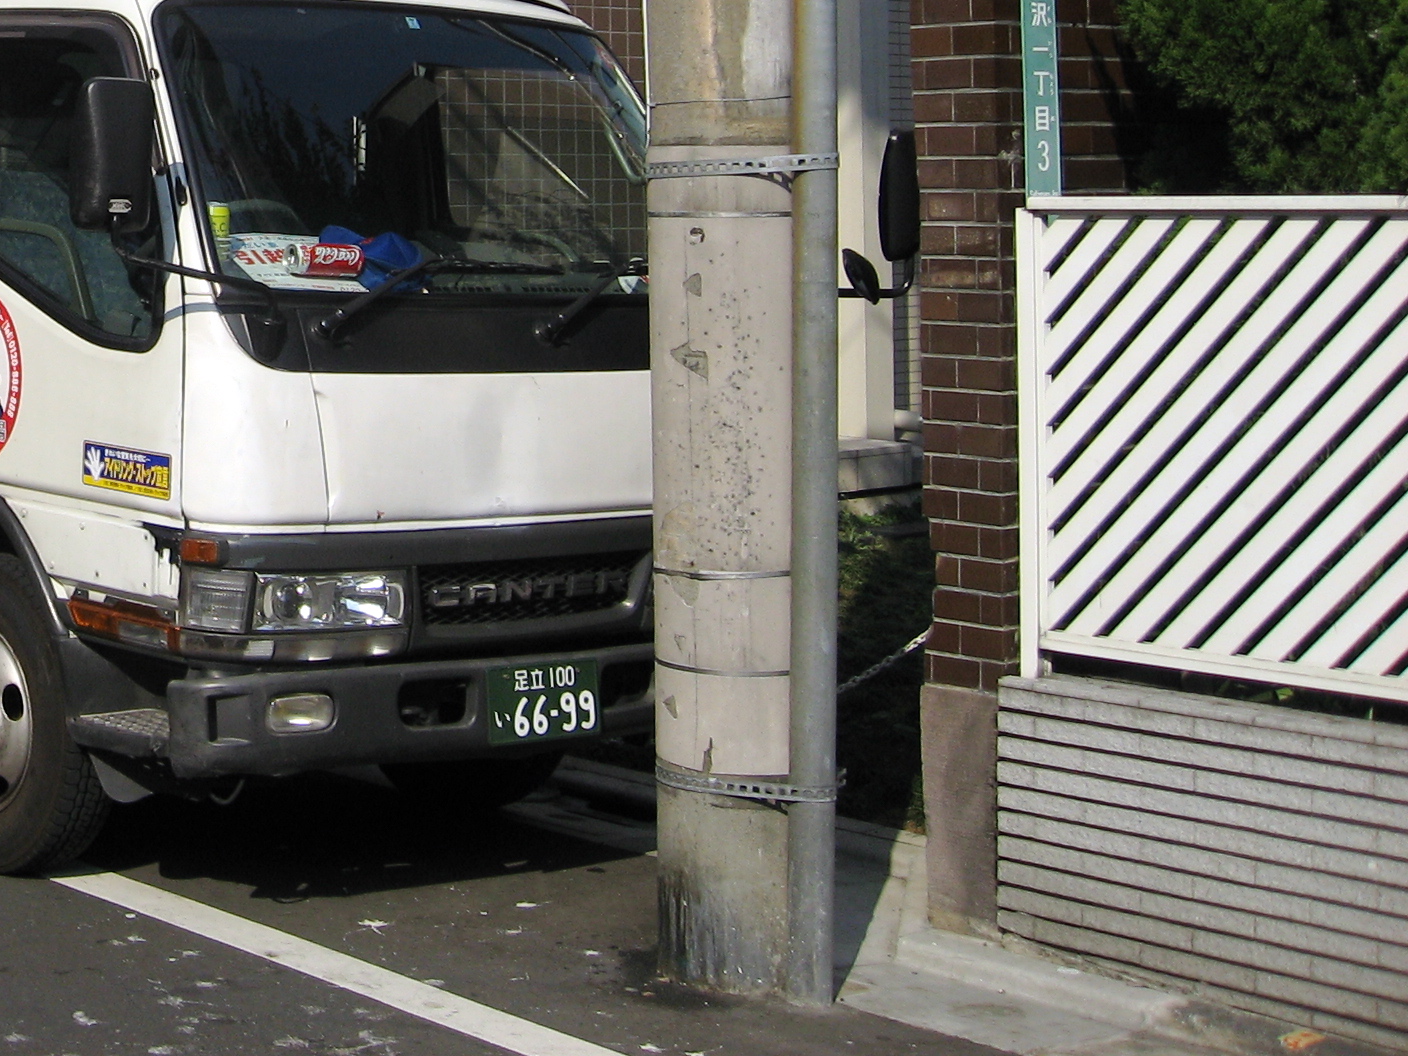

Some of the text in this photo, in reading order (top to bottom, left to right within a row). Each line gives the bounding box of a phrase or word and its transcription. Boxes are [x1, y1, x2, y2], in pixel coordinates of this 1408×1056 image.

[430, 571, 626, 607] CANTER
[514, 665, 575, 692] 足立 100
[494, 690, 596, 738] い 66-99
